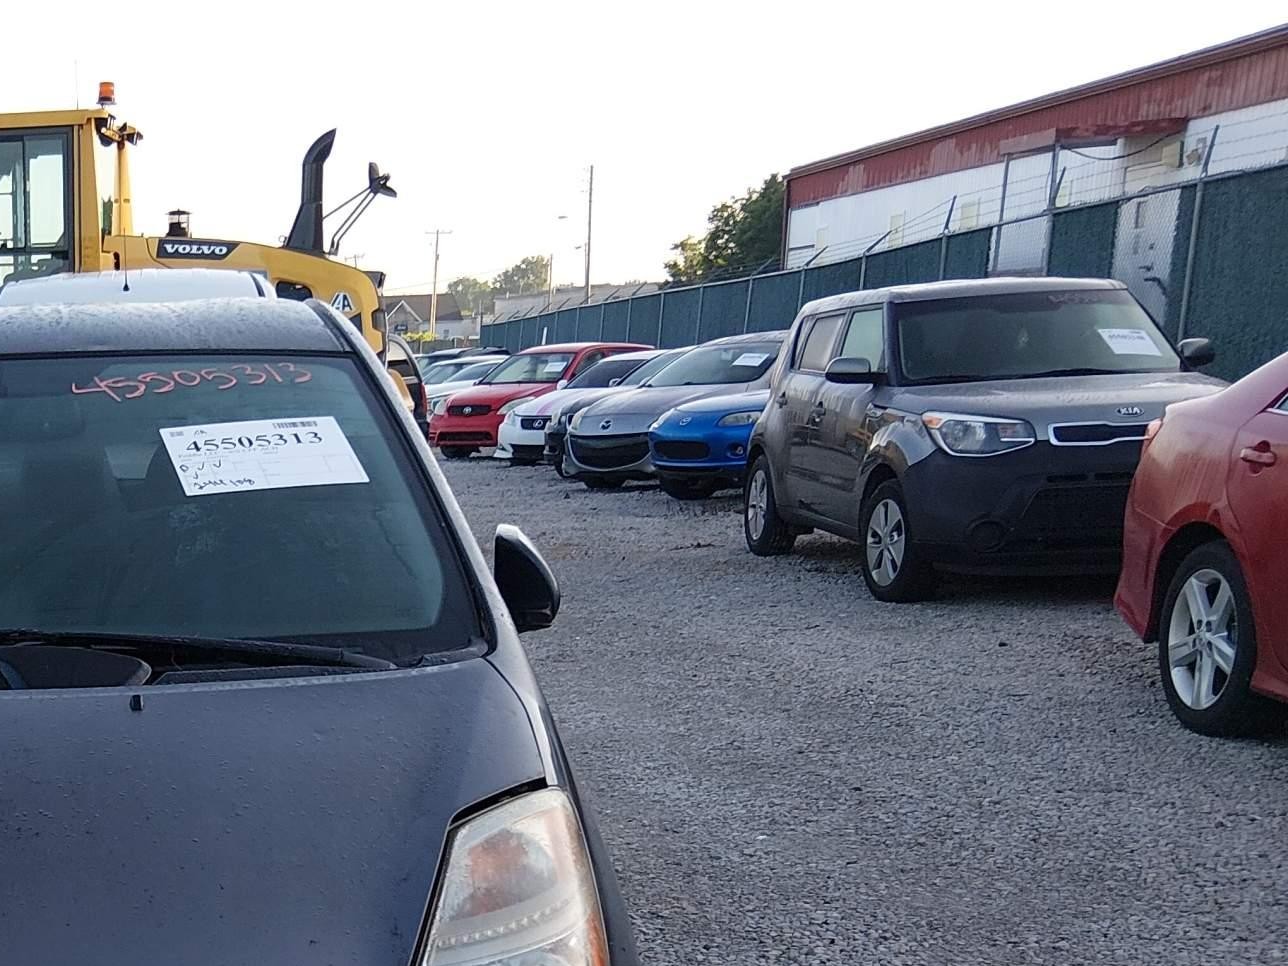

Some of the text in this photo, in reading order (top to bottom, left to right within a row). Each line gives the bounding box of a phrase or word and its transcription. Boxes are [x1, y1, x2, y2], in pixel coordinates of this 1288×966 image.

[164, 244, 228, 255] VOLVO
[72, 362, 312, 402] 45505313
[186, 431, 324, 452] 45505313
